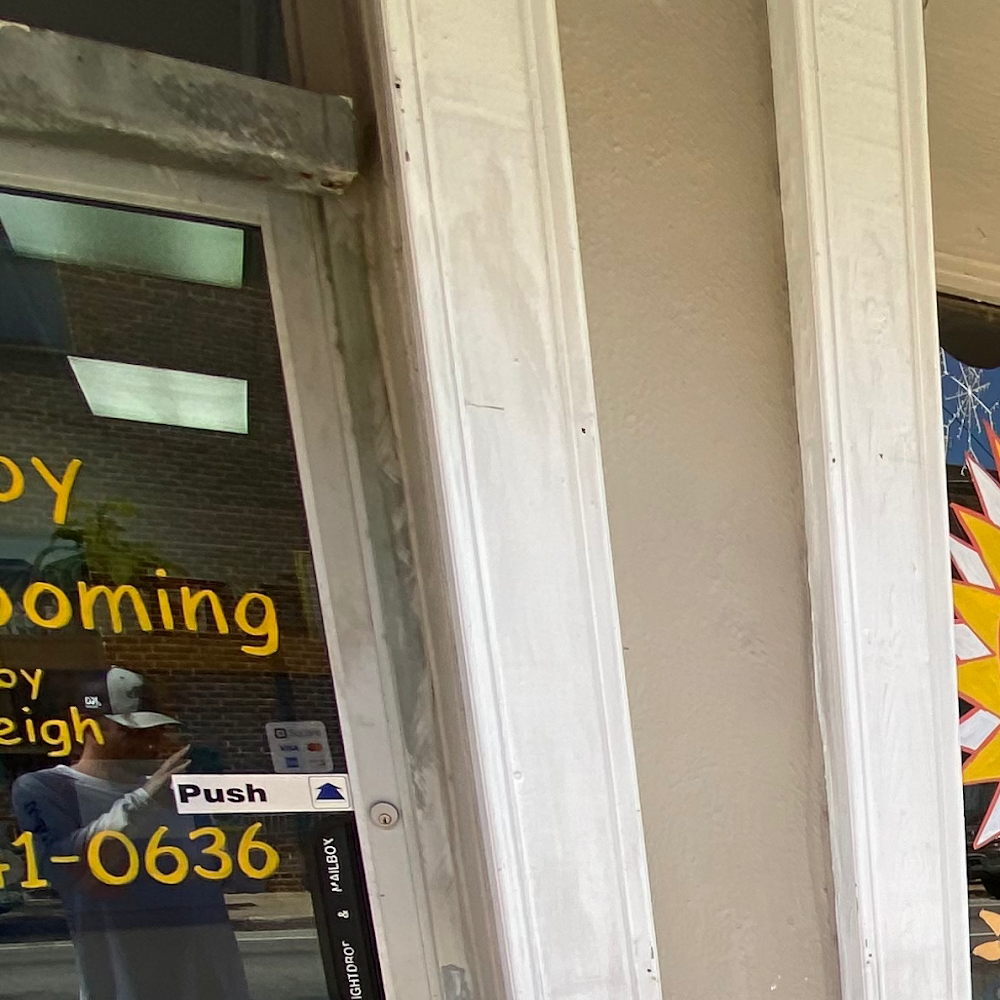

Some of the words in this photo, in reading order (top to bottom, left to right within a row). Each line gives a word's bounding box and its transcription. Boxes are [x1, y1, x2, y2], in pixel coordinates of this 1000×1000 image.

[0, 568, 279, 656] oming
[178, 784, 267, 804] Push
[337, 909, 349, 919] &
